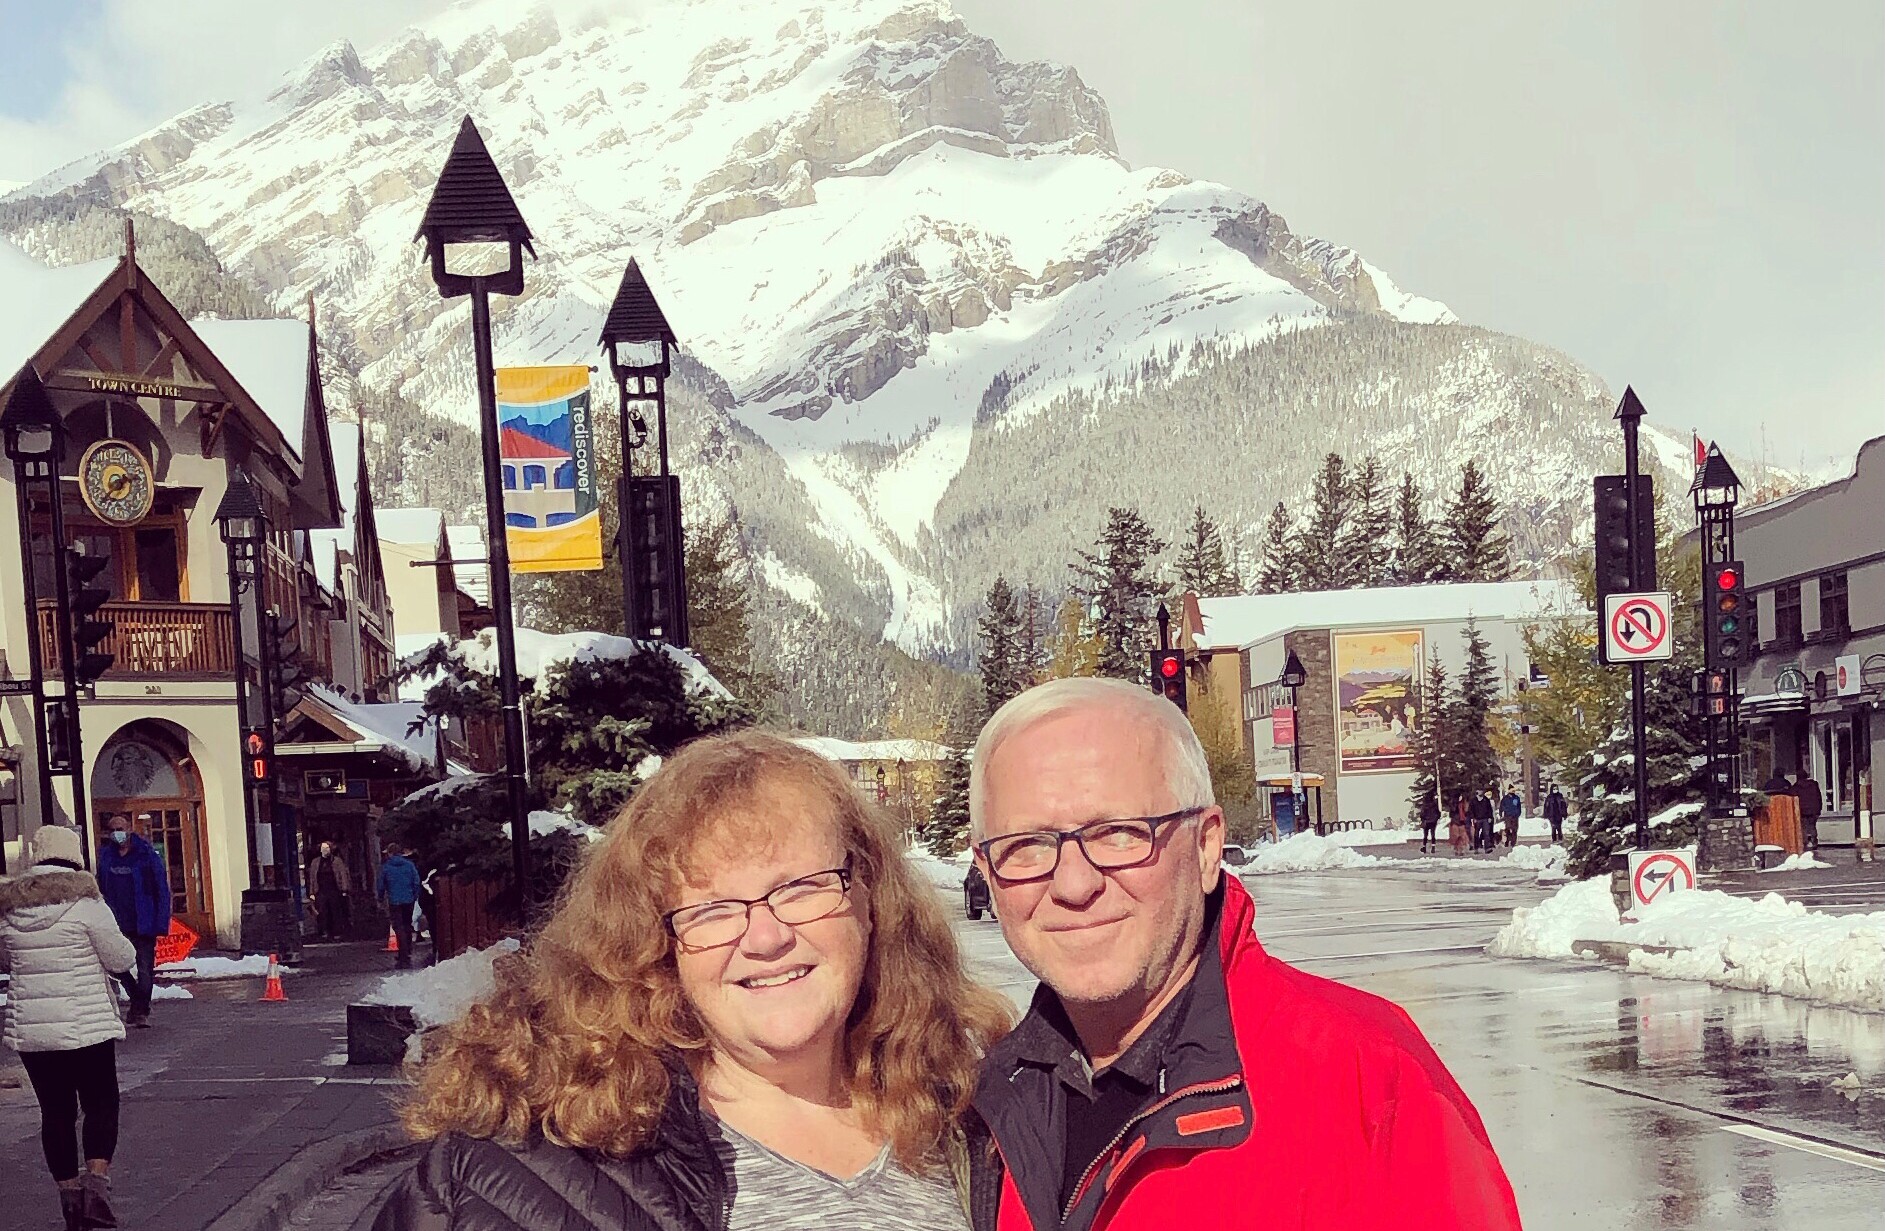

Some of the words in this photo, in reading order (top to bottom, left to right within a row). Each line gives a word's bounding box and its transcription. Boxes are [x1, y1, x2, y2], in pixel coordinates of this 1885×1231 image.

[88, 377, 129, 393] TOWN
[131, 382, 182, 397] CENTRE
[573, 406, 590, 495] rediscover
